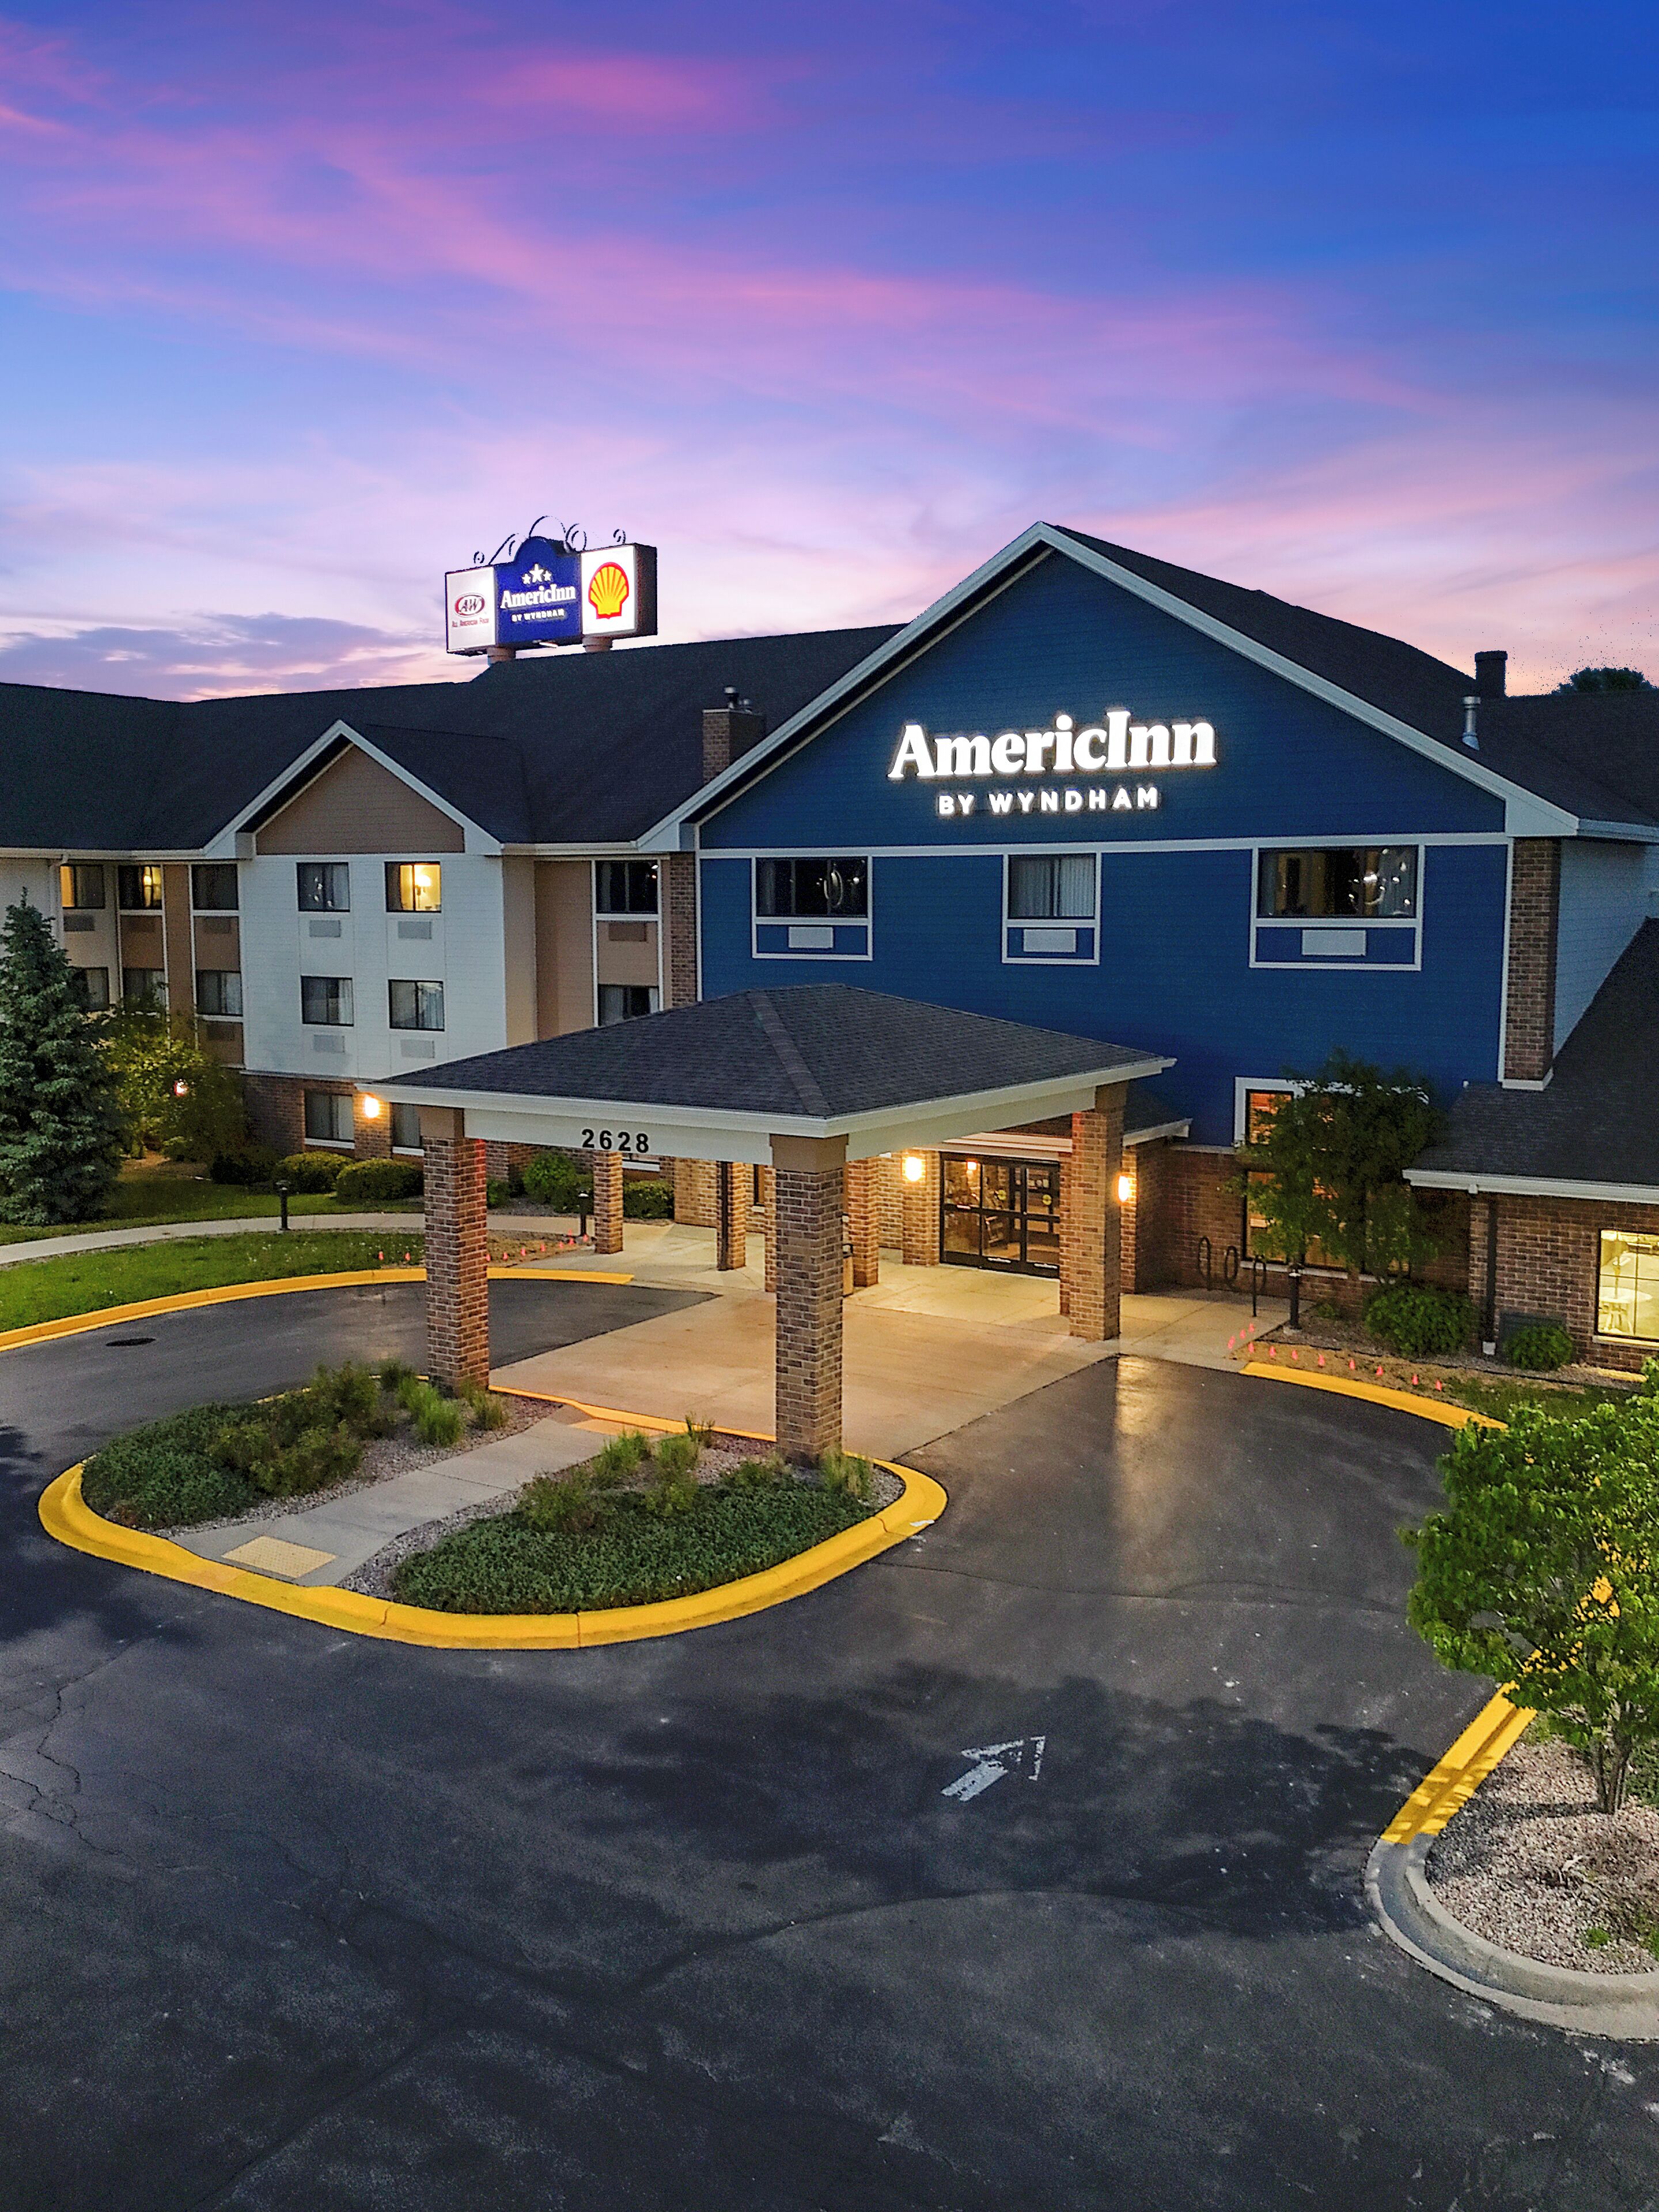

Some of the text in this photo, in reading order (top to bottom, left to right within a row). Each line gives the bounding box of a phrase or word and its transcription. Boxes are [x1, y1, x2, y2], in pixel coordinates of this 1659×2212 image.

[500, 584, 576, 609] AmericInn
[511, 608, 565, 623] BY WYNDHAM
[887, 710, 1217, 778] AmericInn
[938, 786, 1158, 816] BY WYNDHAM
[582, 1128, 649, 1153] 2628
